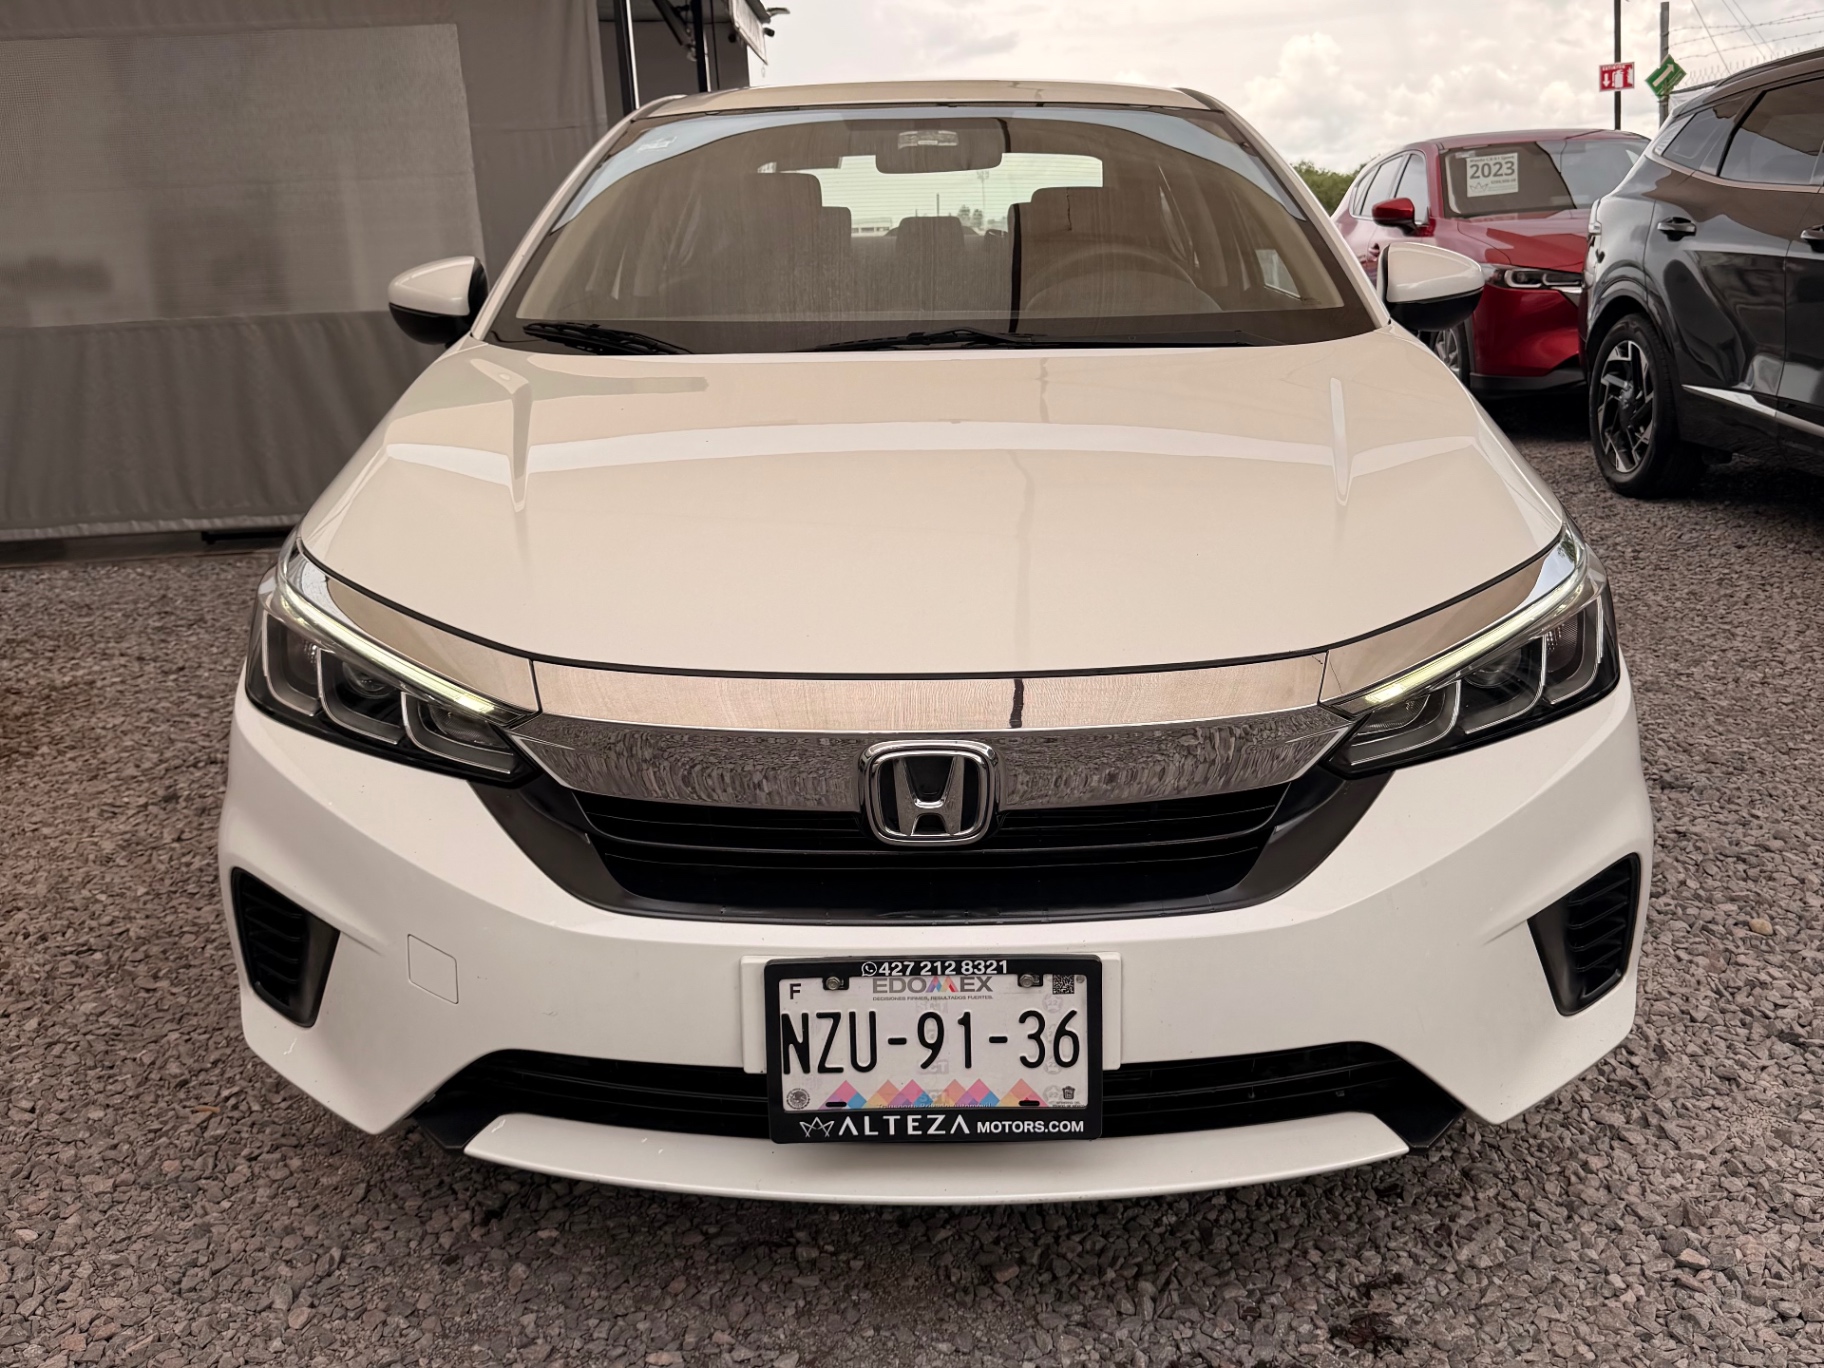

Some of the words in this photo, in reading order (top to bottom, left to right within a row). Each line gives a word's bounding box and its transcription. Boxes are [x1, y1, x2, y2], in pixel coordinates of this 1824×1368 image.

[1469, 160, 1515, 180] 2023
[878, 961, 915, 976] 427
[920, 960, 956, 976] 212
[961, 959, 1008, 975] 8321
[789, 983, 801, 1000] F
[872, 976, 993, 994] EDOMEX
[781, 1010, 1079, 1074] NZU-91-36
[838, 1114, 970, 1136] ALTEZA
[976, 1120, 1084, 1134] MOTORS.COM
